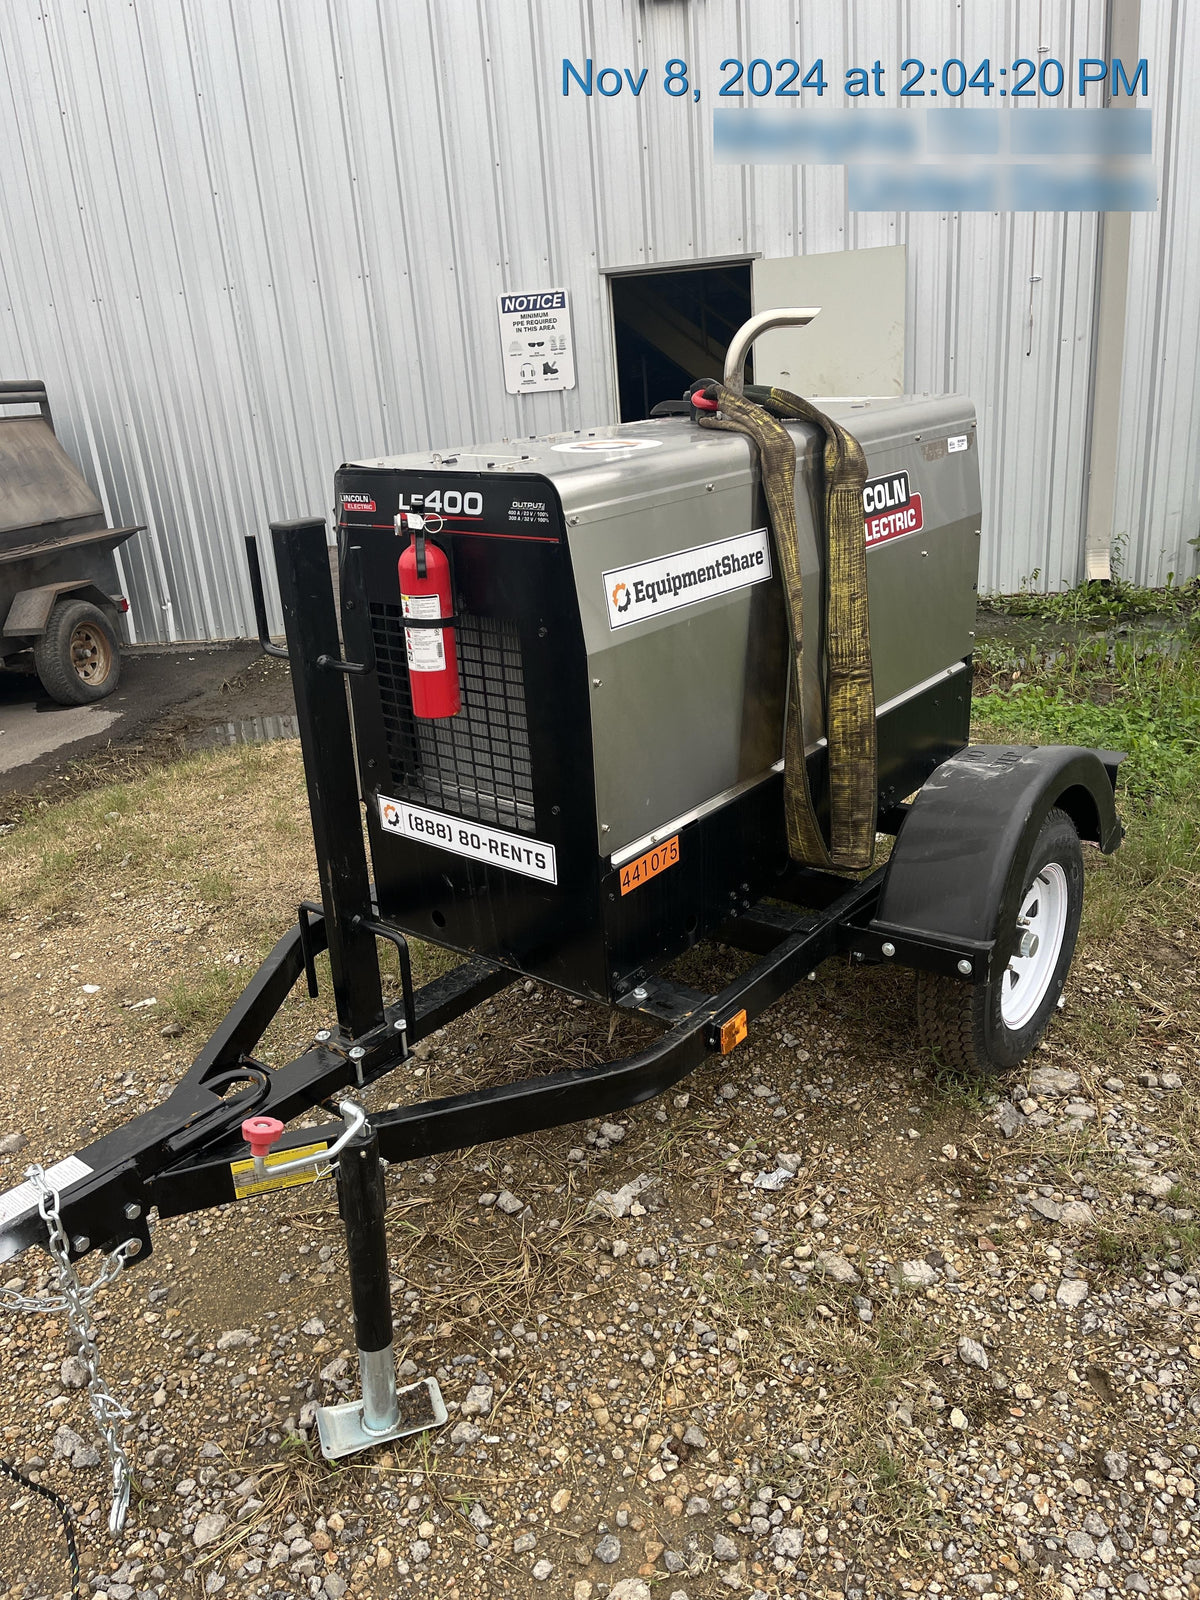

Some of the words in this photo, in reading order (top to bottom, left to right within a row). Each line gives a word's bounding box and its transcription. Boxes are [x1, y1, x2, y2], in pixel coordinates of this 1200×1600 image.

[504, 294, 562, 312] NOTICE
[520, 312, 549, 320] MINIMUM
[526, 318, 558, 326] REQUIRED
[340, 494, 369, 503] LINCOLN
[512, 501, 543, 509] OUTPUT
[863, 477, 907, 513] COLN
[864, 508, 916, 542] LECTRIC
[632, 550, 764, 604] EquipmentShare
[408, 813, 453, 842] (888)
[458, 829, 546, 870] 80-RENTS
[622, 841, 678, 888] 441075
